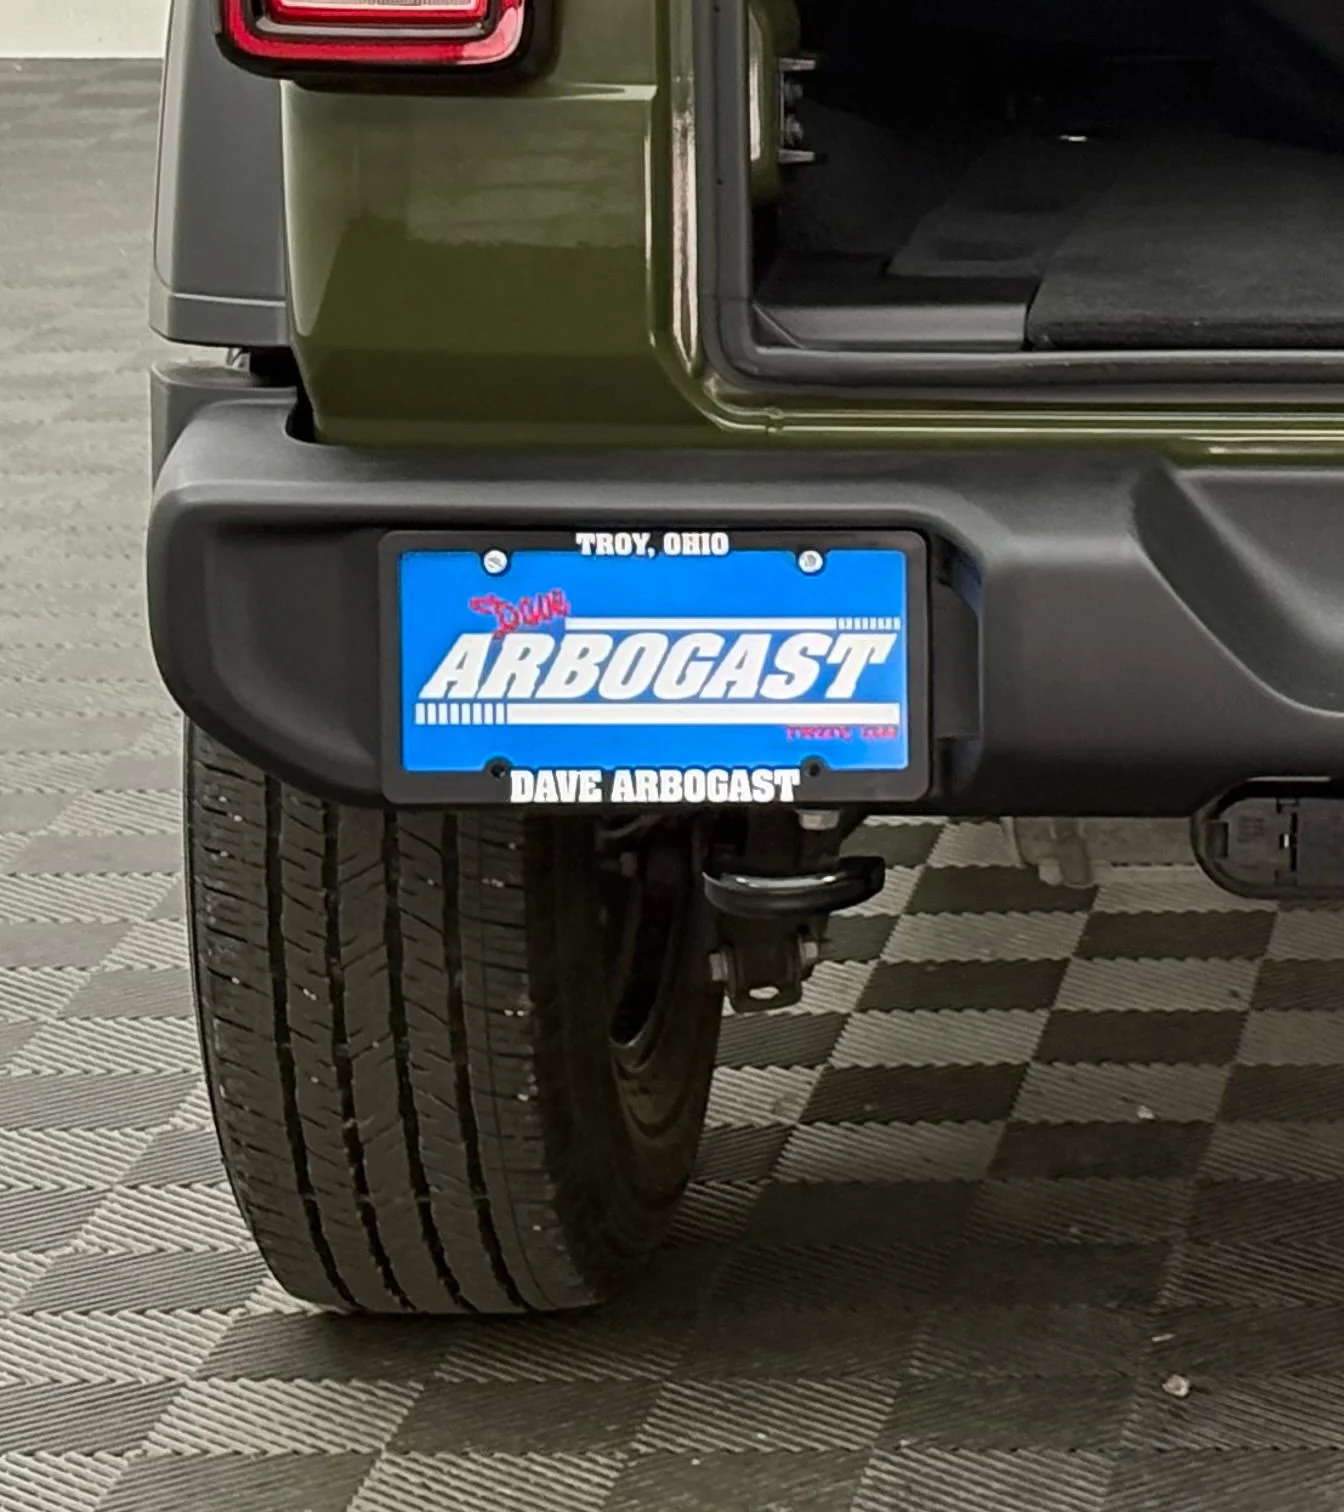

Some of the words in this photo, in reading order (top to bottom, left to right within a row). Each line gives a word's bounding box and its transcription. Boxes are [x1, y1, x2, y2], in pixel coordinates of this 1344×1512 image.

[575, 532, 655, 556] TROY,
[663, 532, 730, 556] OHIO
[419, 632, 898, 700] ARBOGAST
[510, 770, 602, 803] DAVE
[610, 769, 801, 803] ARBOGAST
